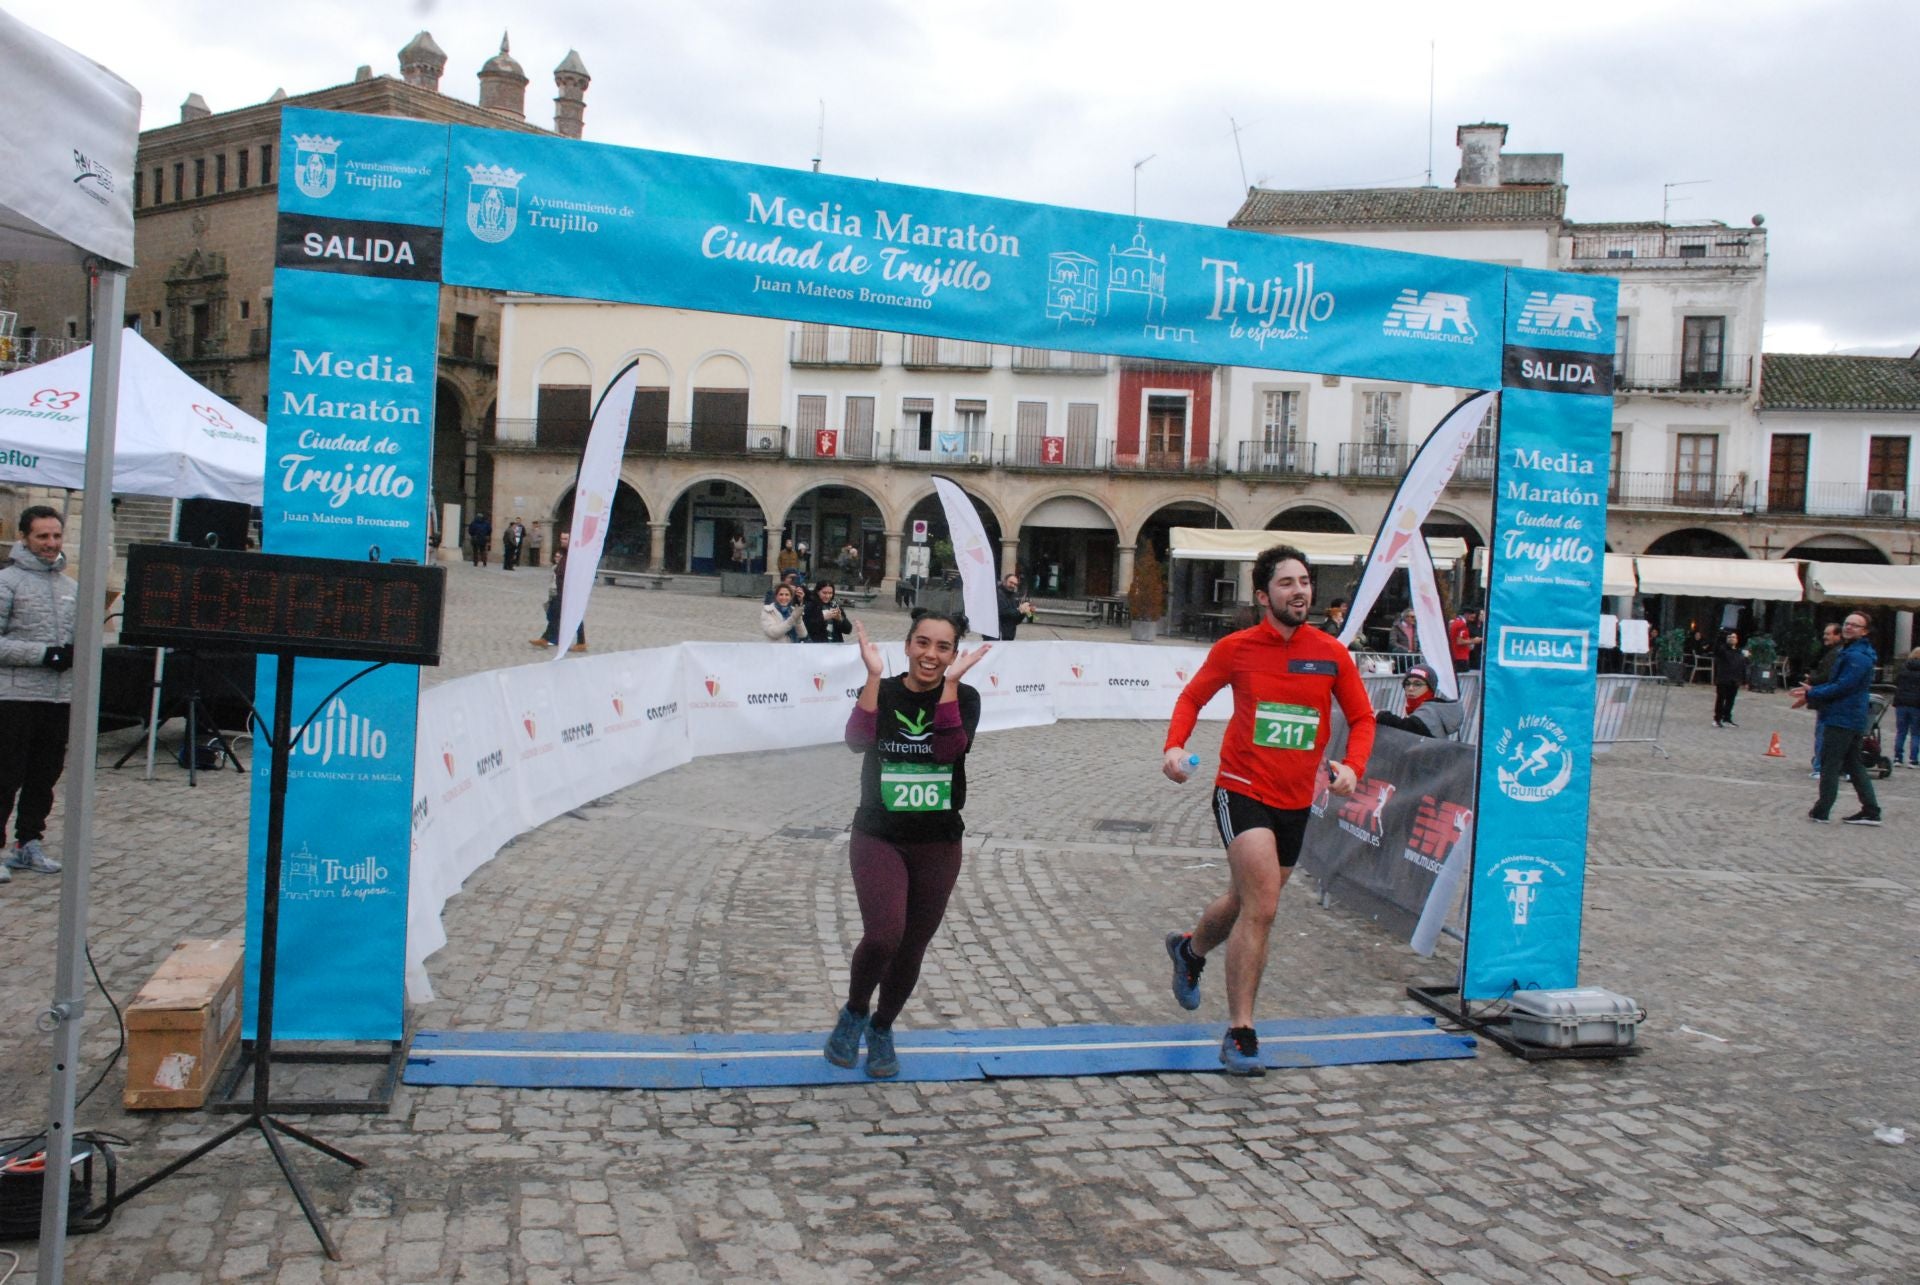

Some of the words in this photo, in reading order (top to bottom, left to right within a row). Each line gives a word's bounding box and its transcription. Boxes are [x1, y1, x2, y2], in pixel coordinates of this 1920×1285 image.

[345, 160, 417, 175] Ayuntamiento
[419, 166, 432, 176] de
[345, 172, 402, 191] Trujillo
[529, 195, 617, 216] Ayuntamiento
[619, 206, 635, 218] de
[528, 210, 599, 234] Trujillo
[746, 192, 863, 238] Media
[873, 210, 1020, 257] Maratón
[303, 232, 415, 265] SALIDA
[702, 225, 824, 269] Ciudad
[828, 245, 872, 275] de
[879, 247, 991, 297] Trujillo
[753, 275, 792, 293] Juan
[796, 280, 855, 300] Mateos
[859, 287, 932, 310] Broncano
[1201, 257, 1335, 333] Trujillo
[1230, 317, 1246, 338] te
[1383, 328, 1474, 345] www.musicrun.es
[291, 350, 415, 384] Media
[1521, 359, 1596, 384] SALIDA
[0, 407, 79, 423] rimaflor
[281, 392, 422, 424] Maratón
[298, 429, 371, 453] Ciudad
[374, 437, 401, 455] de
[0, 449, 40, 469] aflor
[1513, 448, 1594, 475] Media
[279, 454, 415, 508] Trujillo
[1506, 481, 1599, 506] Maratón
[282, 511, 310, 523] Juan
[312, 513, 353, 525] Mateos
[356, 516, 410, 529] Broncano
[1516, 510, 1562, 528] Ciudad
[1564, 516, 1583, 530] de
[1503, 529, 1594, 571] Trujillo
[1511, 639, 1575, 658] HABLA
[288, 697, 387, 766] rujillo
[1266, 722, 1304, 745] 211
[1495, 727, 1513, 755] Club
[1518, 714, 1568, 743] Atletismo
[893, 784, 940, 808] 206
[1502, 780, 1555, 799] TRUJILLO
[321, 856, 388, 885] Trujillo
[341, 885, 351, 898] te
